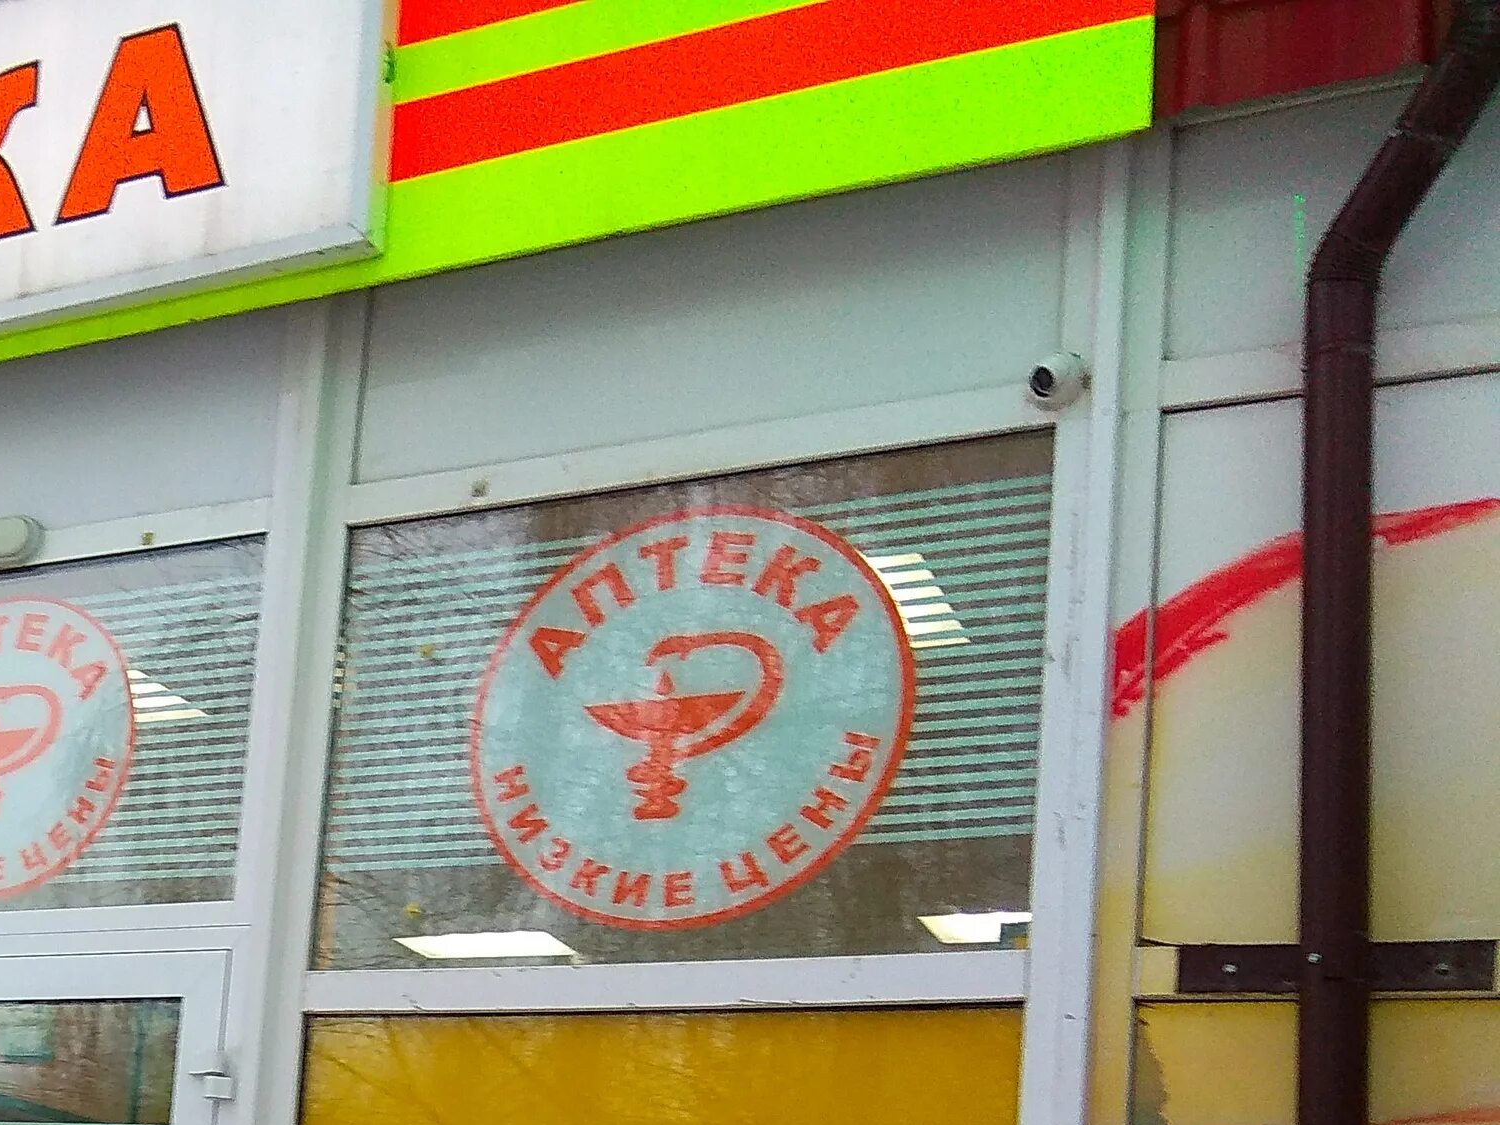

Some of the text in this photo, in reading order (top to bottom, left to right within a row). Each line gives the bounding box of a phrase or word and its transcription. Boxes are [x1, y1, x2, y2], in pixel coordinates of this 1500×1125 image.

[527, 531, 861, 681] АПТЕКА
[19, 756, 117, 871] ЦЕНЫ
[492, 731, 882, 908] НИЗКИЕ ЦЕНЫ
